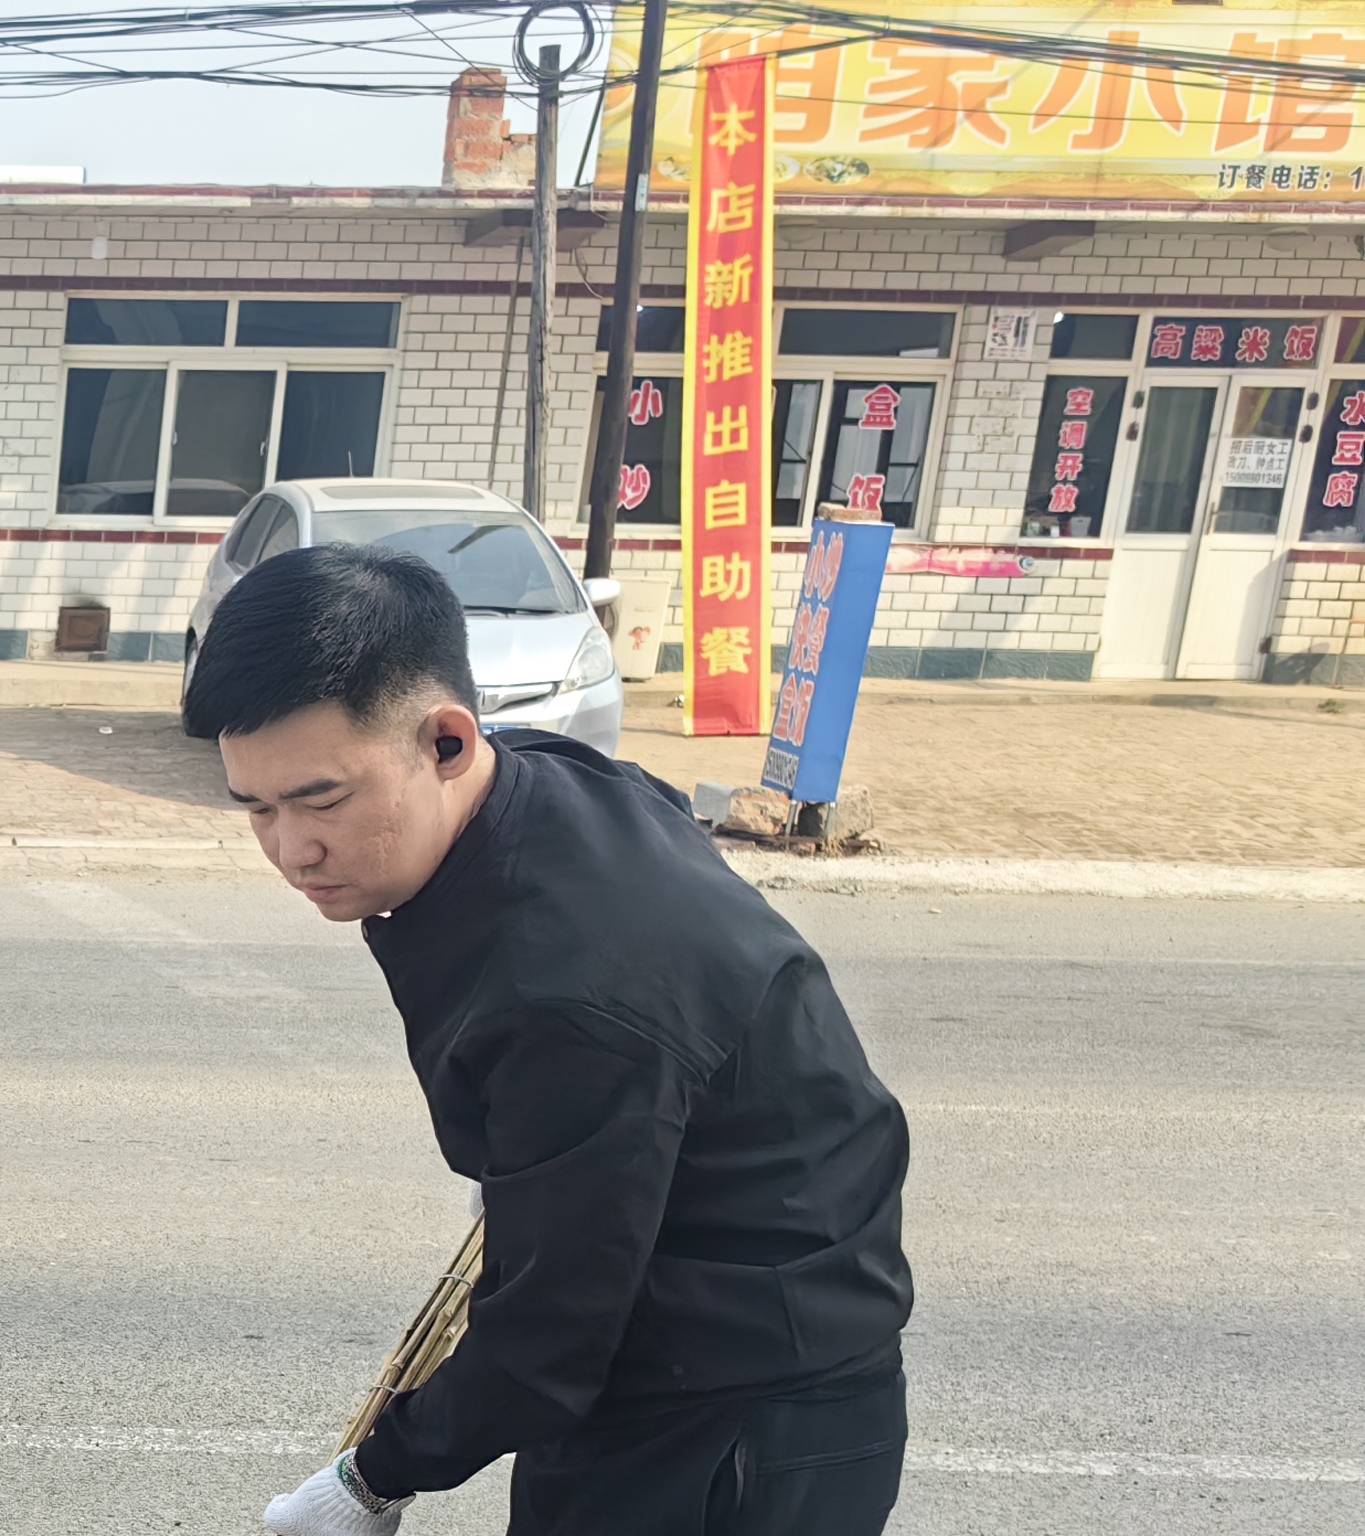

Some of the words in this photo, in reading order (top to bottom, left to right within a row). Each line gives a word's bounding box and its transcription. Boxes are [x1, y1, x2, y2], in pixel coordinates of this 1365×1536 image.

[699, 102, 758, 676] 本店新推出自助餐
[1151, 324, 1318, 362] 高粱米饭
[617, 379, 663, 511] 小炒
[846, 383, 901, 513] 盒饭
[1047, 386, 1095, 513] 空调开放
[804, 530, 844, 602] 小炒
[772, 672, 816, 747] 盒饭
